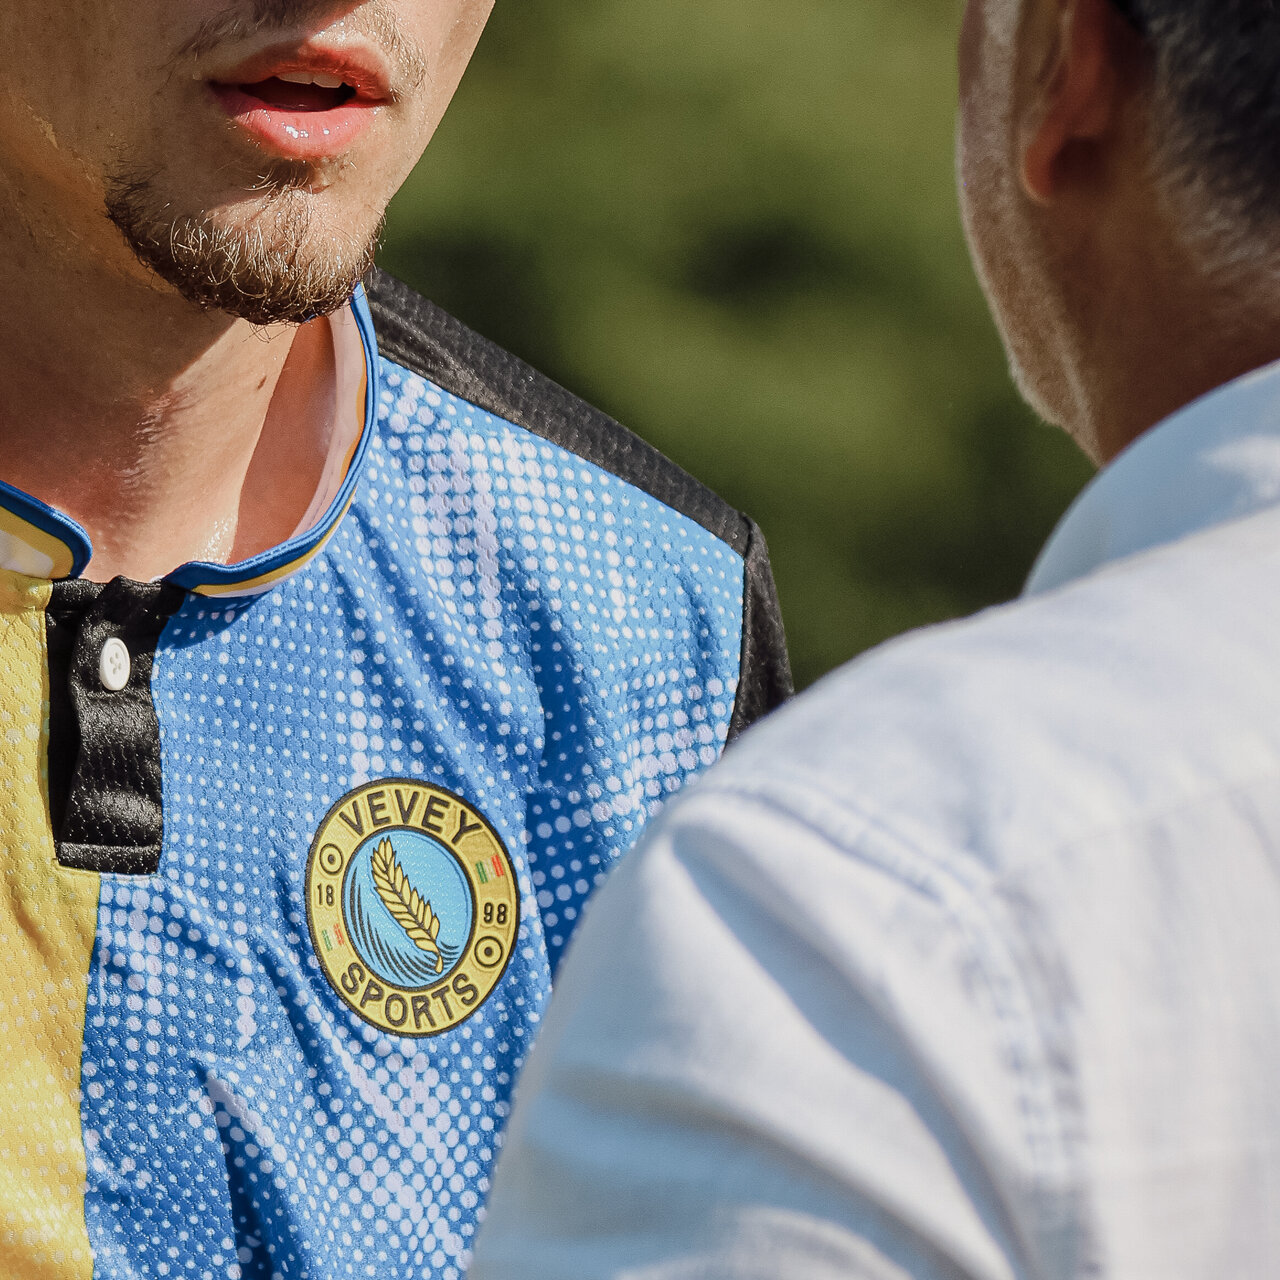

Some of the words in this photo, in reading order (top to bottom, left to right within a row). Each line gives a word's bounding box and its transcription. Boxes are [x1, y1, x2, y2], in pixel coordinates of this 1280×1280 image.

[339, 789, 482, 844] VEVEY
[317, 884, 335, 907] 18
[483, 902, 508, 925] 98
[340, 962, 479, 1029] SPORTS
